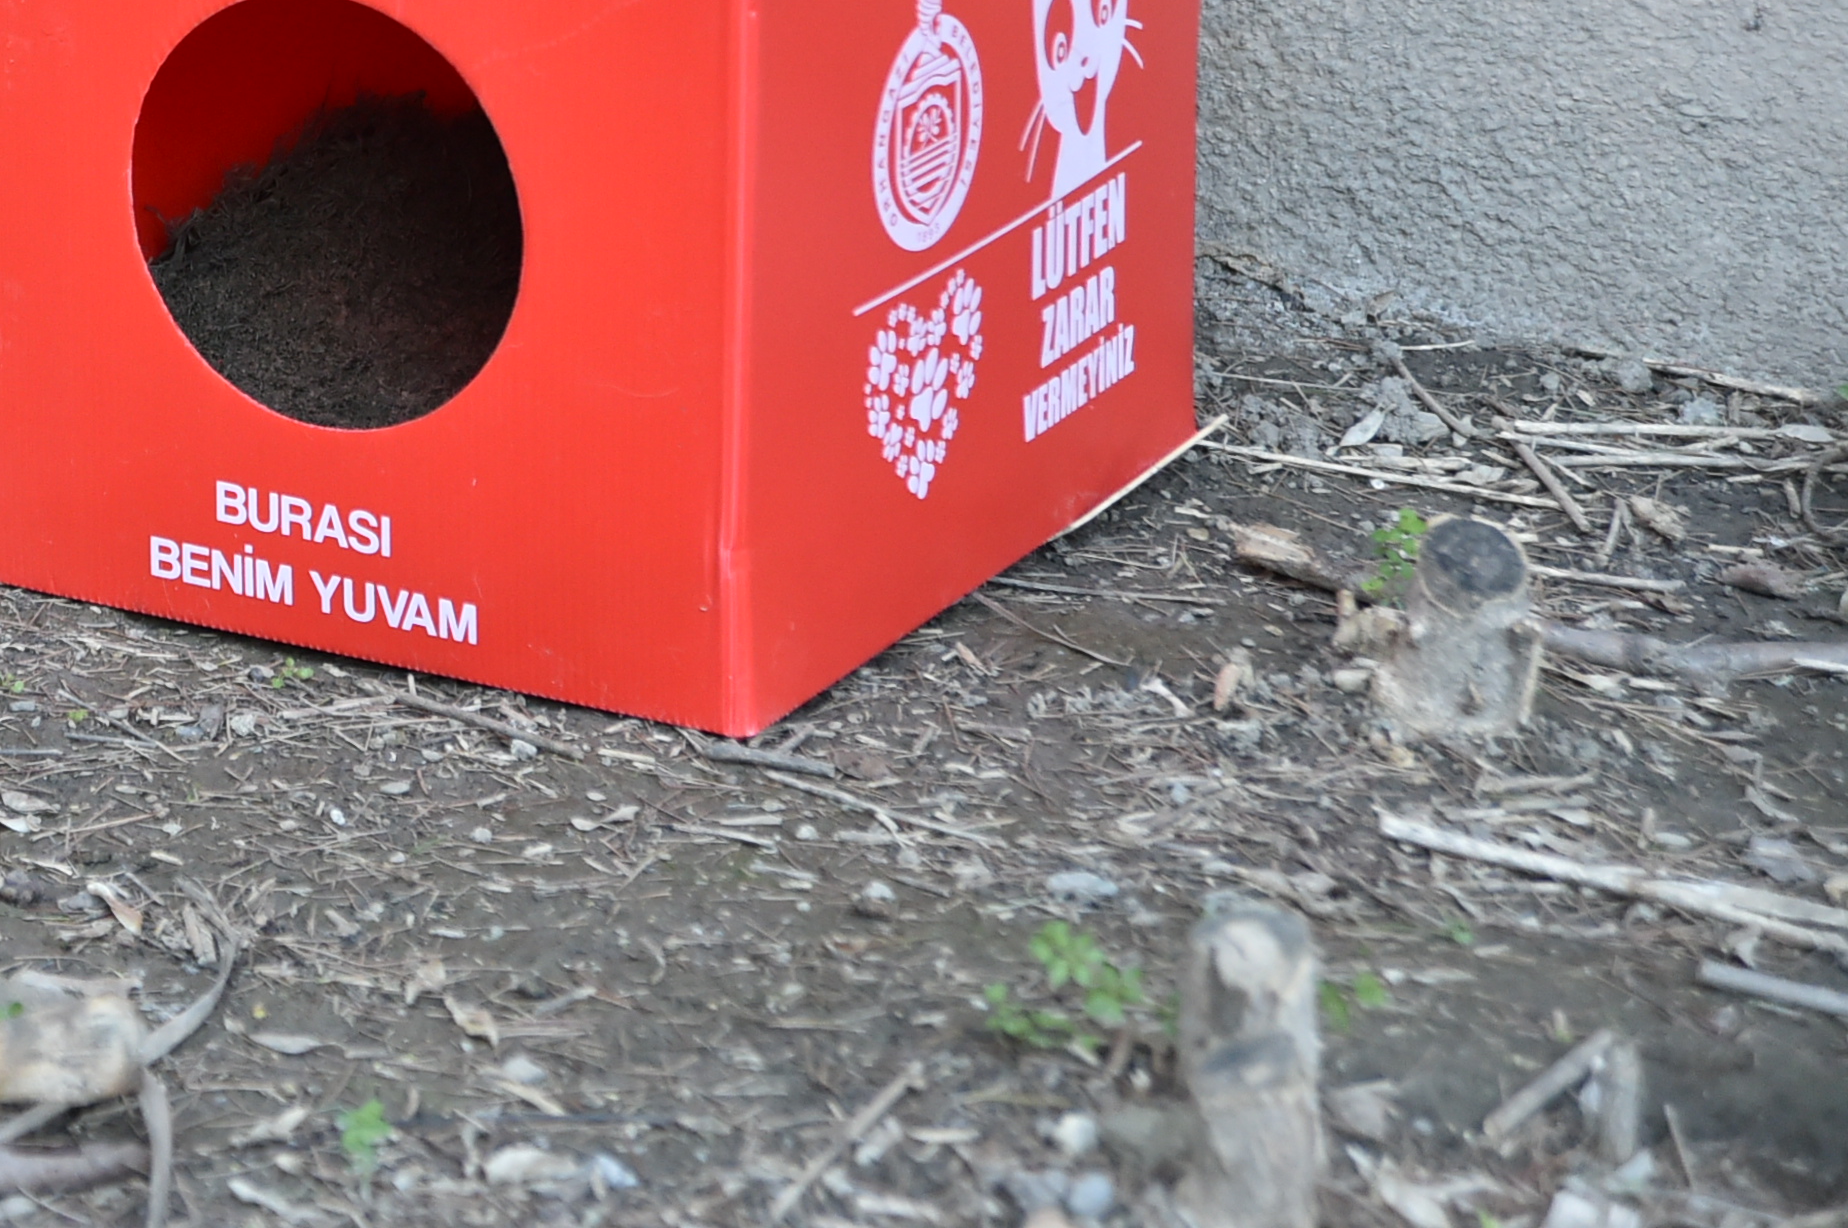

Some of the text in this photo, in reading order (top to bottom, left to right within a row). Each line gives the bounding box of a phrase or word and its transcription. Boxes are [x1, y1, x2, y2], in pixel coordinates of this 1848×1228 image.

[1031, 171, 1126, 300] LÜTFEN
[1041, 266, 1115, 369] ZARAR
[1023, 323, 1135, 443] VERMEYİNİZ
[215, 480, 391, 557] BURASI
[150, 535, 478, 645] BENİM YUVAM
